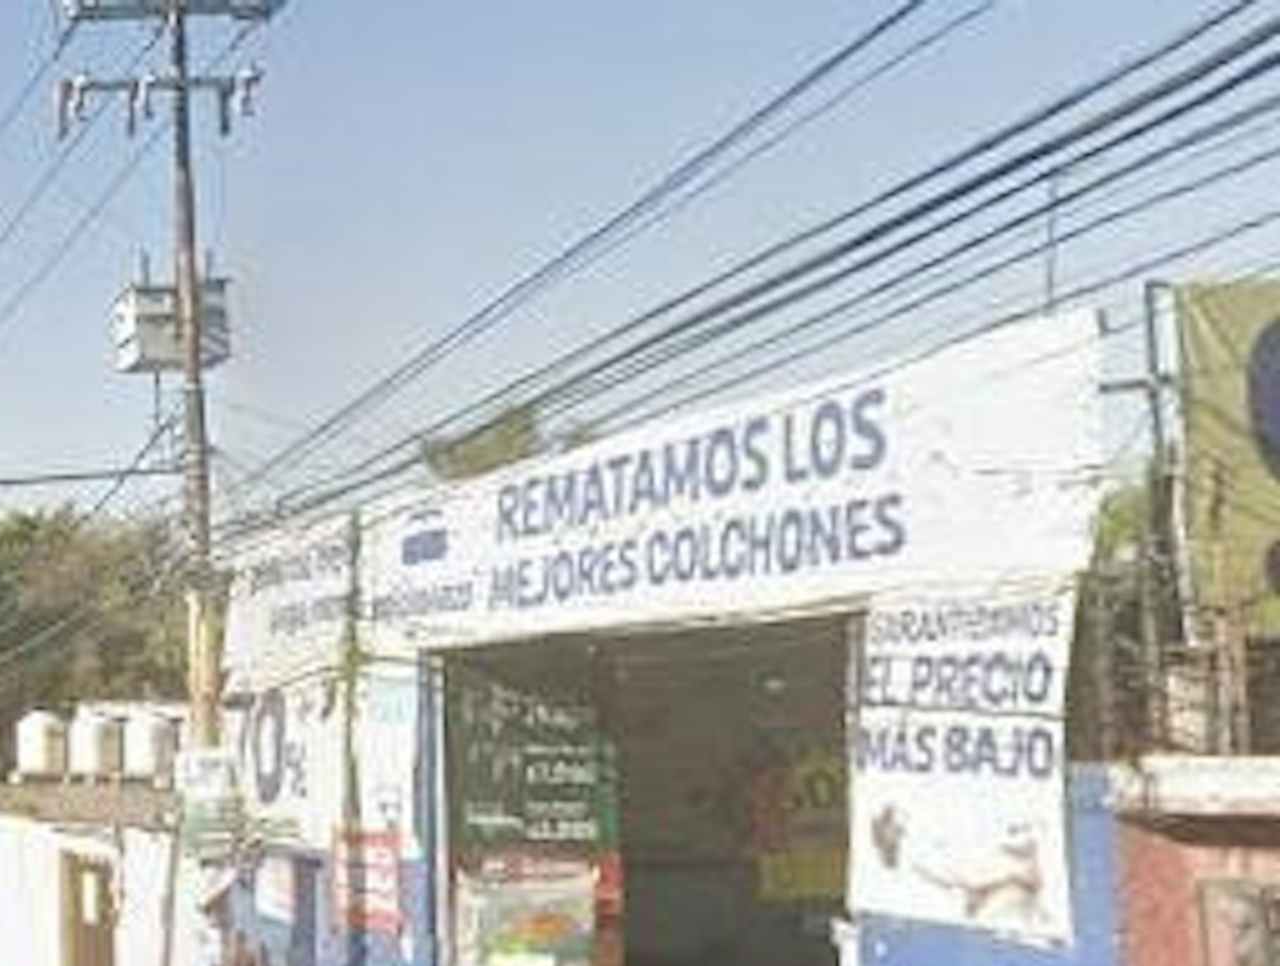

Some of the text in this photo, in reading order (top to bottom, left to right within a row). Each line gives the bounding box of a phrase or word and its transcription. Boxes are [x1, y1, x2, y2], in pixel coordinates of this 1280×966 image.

[496, 387, 888, 542] REMATAMOS LOS
[488, 538, 638, 611] MEJORES
[646, 493, 906, 587] COLCHONES
[864, 652, 1052, 705] EL PRECIO
[944, 725, 1055, 779] BAJO
